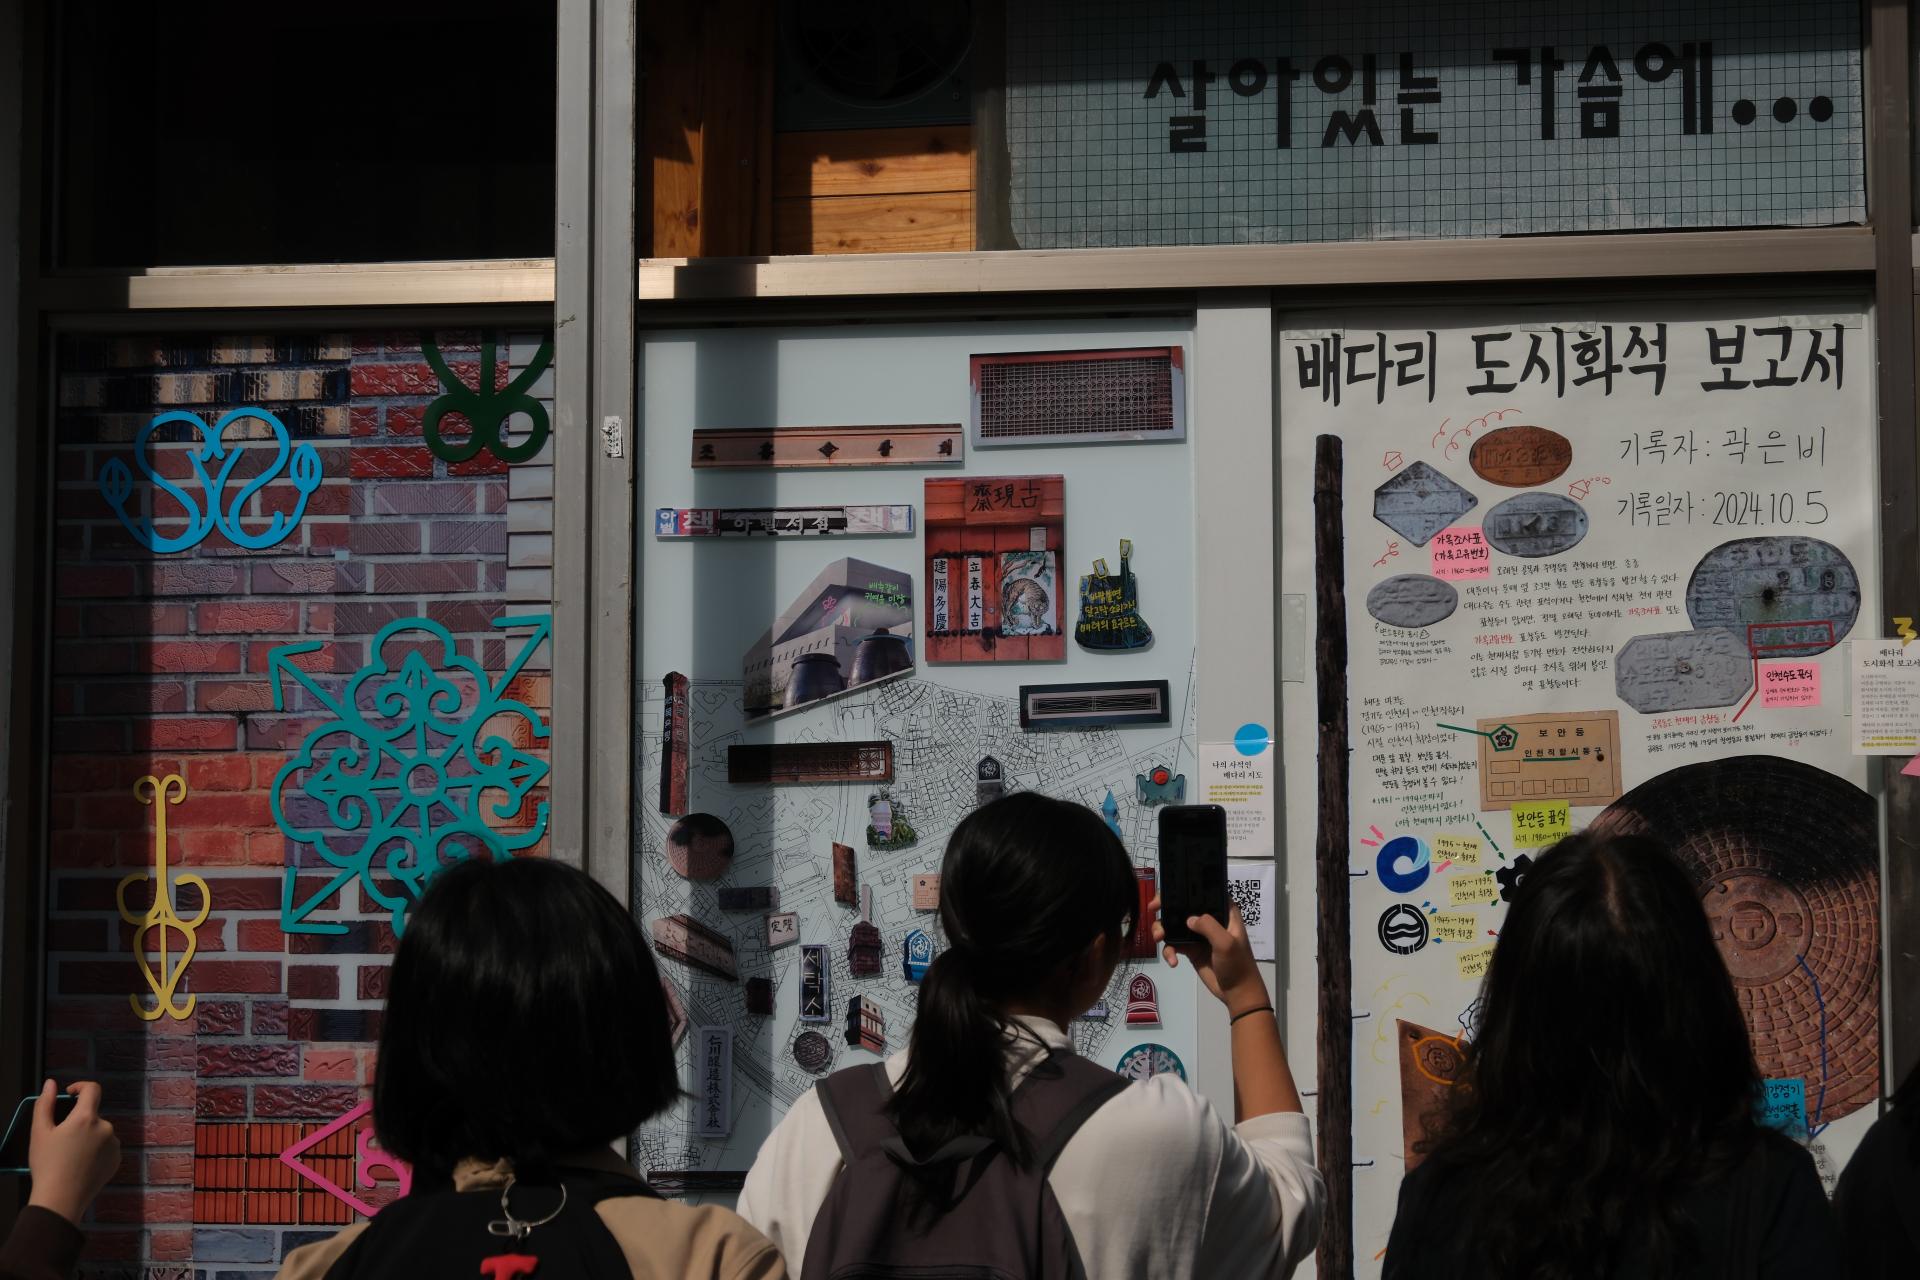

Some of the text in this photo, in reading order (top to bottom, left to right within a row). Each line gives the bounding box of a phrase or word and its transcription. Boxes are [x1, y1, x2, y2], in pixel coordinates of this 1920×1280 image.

[1143, 52, 1442, 153] 살아있는
[1295, 323, 1846, 407] 배다리 도시화석 보고서
[684, 510, 713, 534] 책
[733, 515, 831, 536] 아벨서점
[1436, 532, 1482, 546] 가옥조사표
[969, 561, 982, 632] 立春大吉
[1385, 708, 1410, 719] 인천시
[1387, 735, 1413, 748] 인천시
[1212, 760, 1252, 769] 나의 사적인
[1223, 770, 1264, 780] 배다리 지도
[1516, 809, 1567, 829] 보안등 표식
